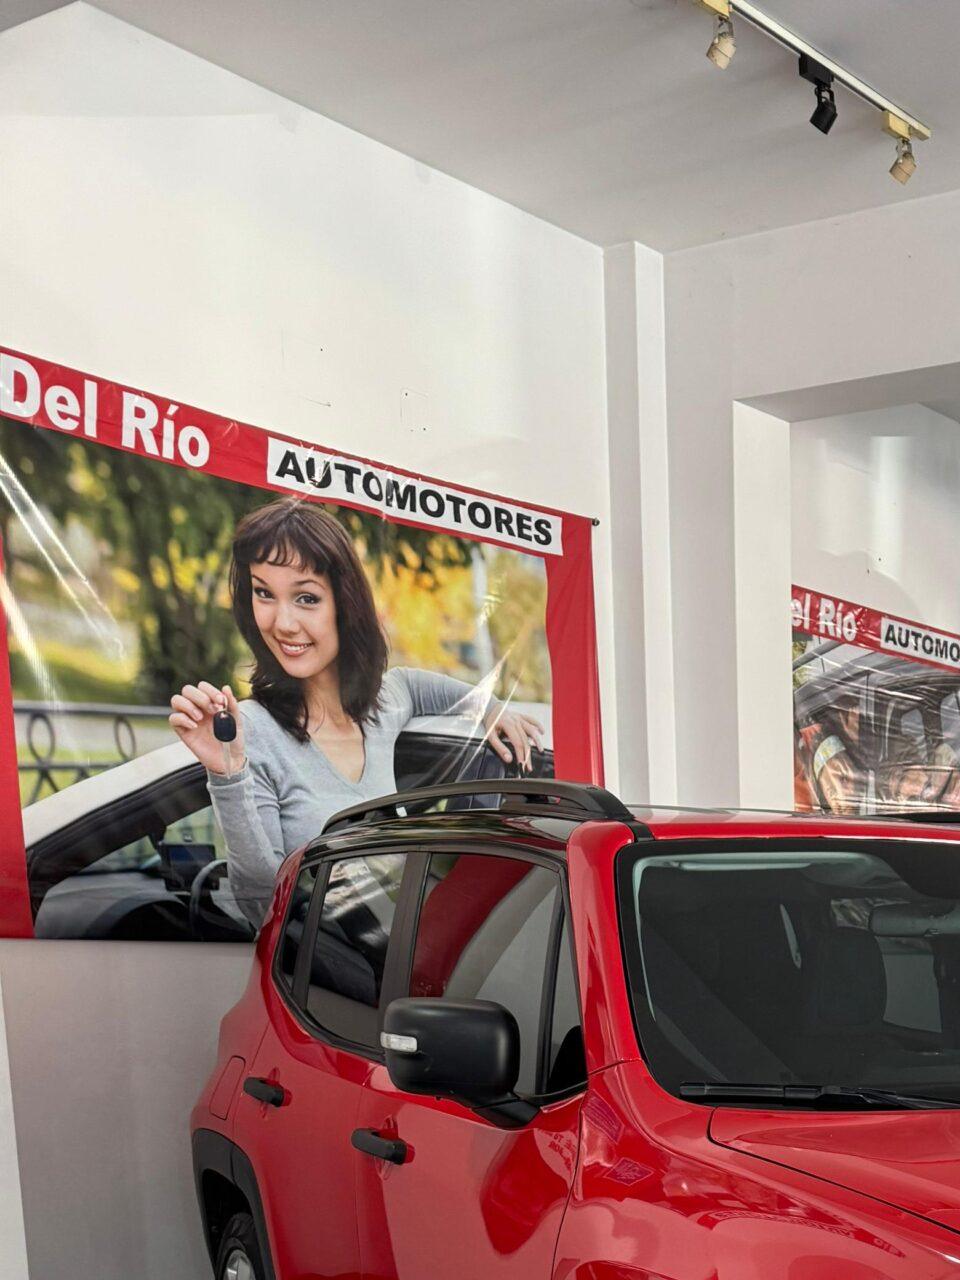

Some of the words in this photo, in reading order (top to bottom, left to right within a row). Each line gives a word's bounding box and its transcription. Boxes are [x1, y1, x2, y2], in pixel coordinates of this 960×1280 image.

[0, 353, 98, 438] Del
[121, 391, 210, 467] Río
[275, 449, 553, 546] AUTOMOTORES
